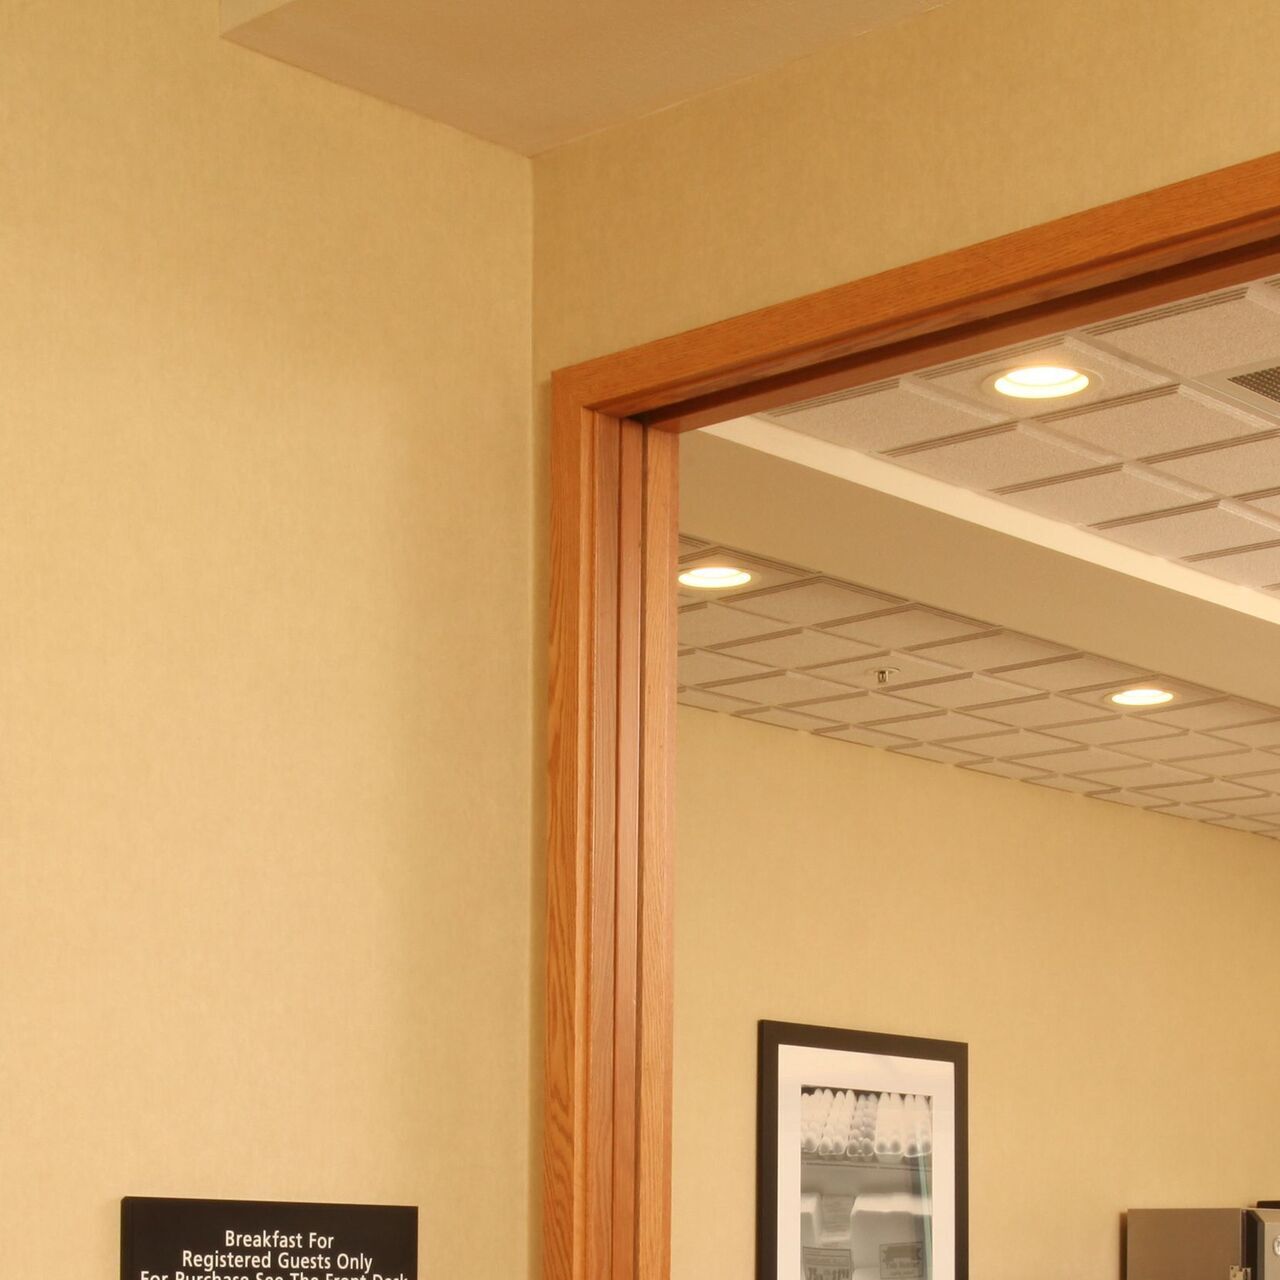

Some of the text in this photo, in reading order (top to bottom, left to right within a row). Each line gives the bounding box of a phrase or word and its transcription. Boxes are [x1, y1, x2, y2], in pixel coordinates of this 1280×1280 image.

[225, 1229, 335, 1249] Breakfast For
[182, 1249, 373, 1274] Registered Guests Only
